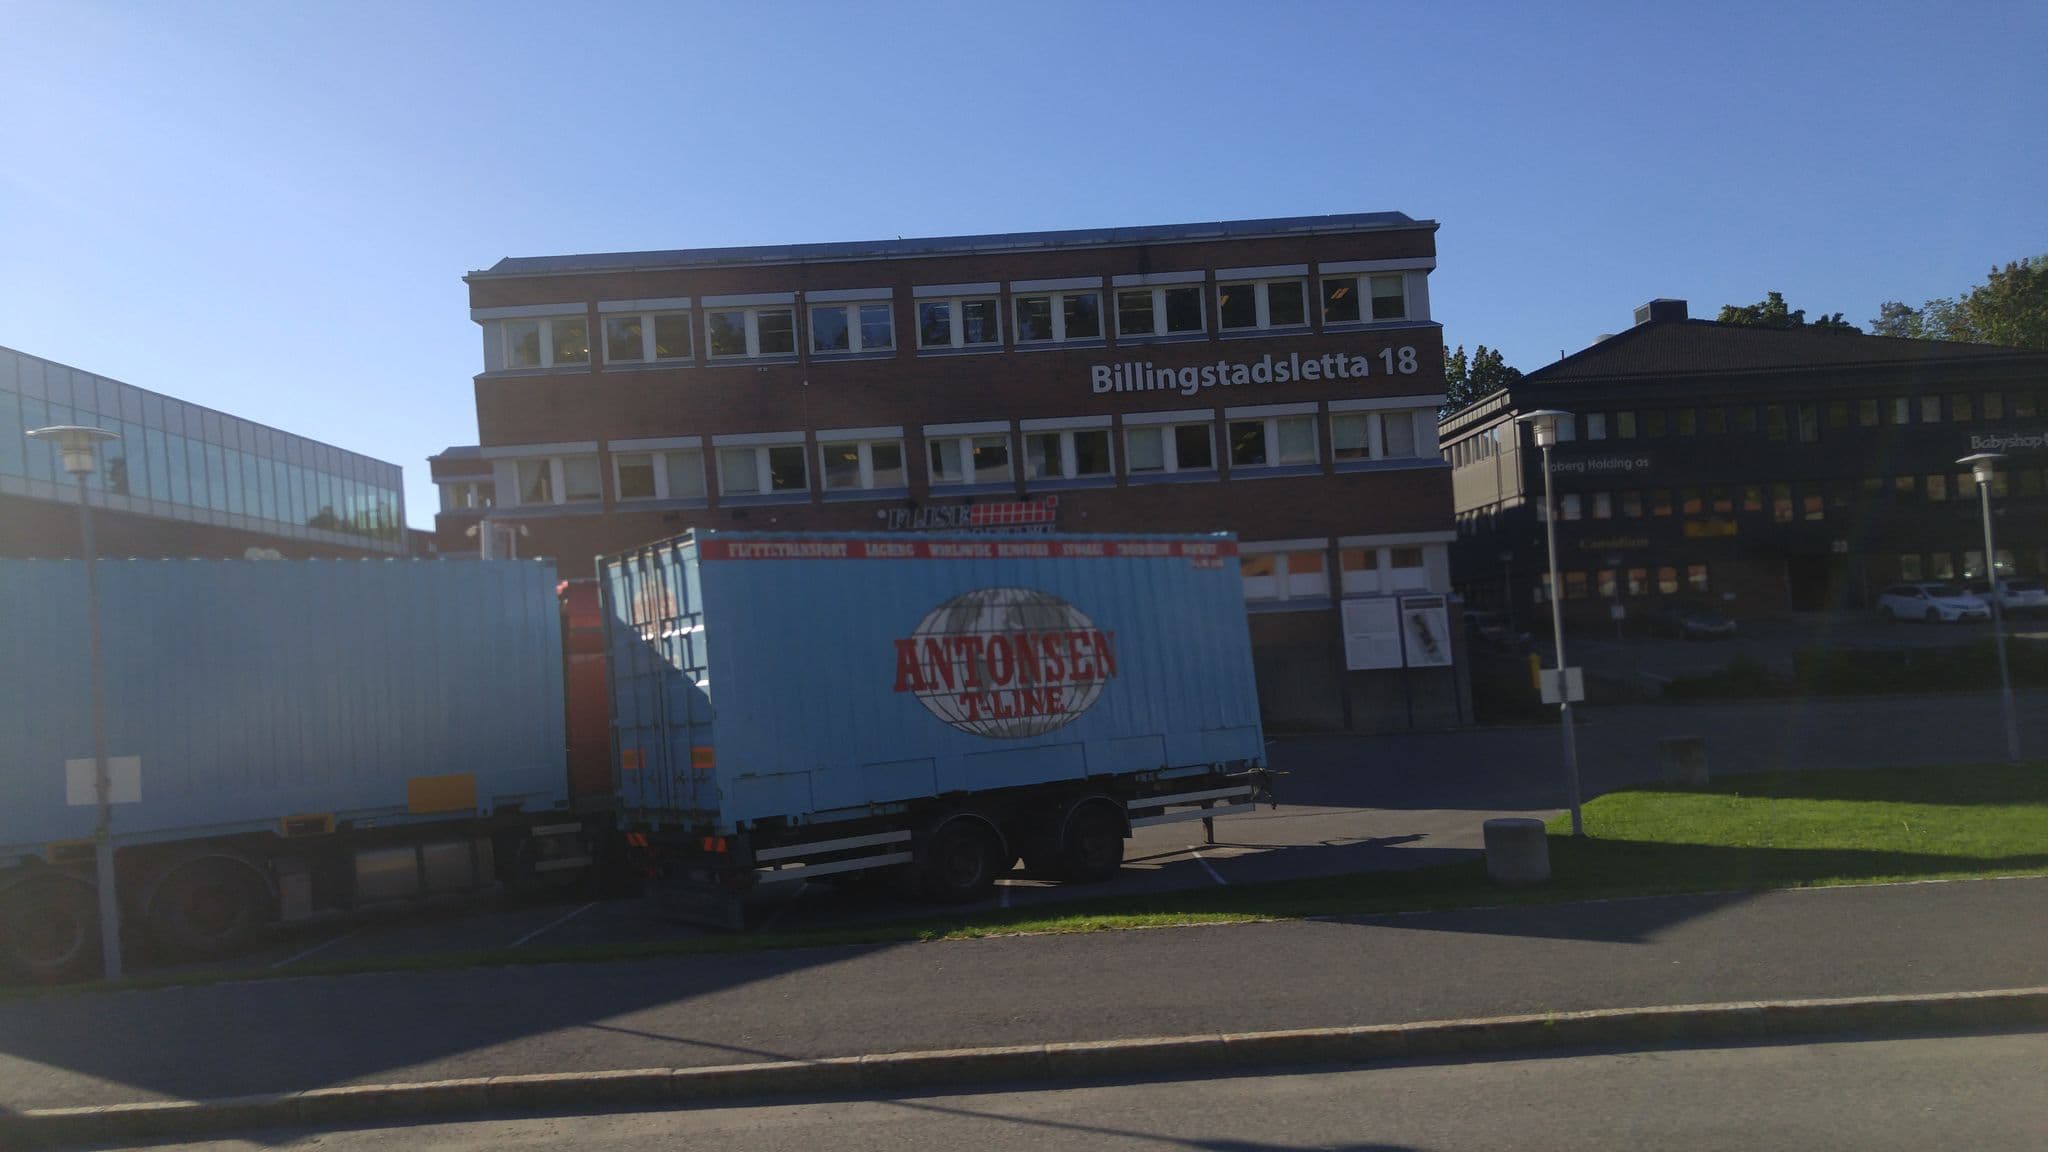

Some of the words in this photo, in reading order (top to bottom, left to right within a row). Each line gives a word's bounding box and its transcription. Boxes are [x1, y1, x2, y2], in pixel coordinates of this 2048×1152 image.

[1091, 352, 1370, 396] Billingstadsletta
[1378, 345, 1419, 375] 18
[1971, 433, 2042, 453] Babyshop
[1588, 457, 1632, 471] Holding
[1635, 458, 1649, 467] as
[893, 629, 1117, 693] ANTONSEN
[960, 687, 1067, 722] T-LINE
